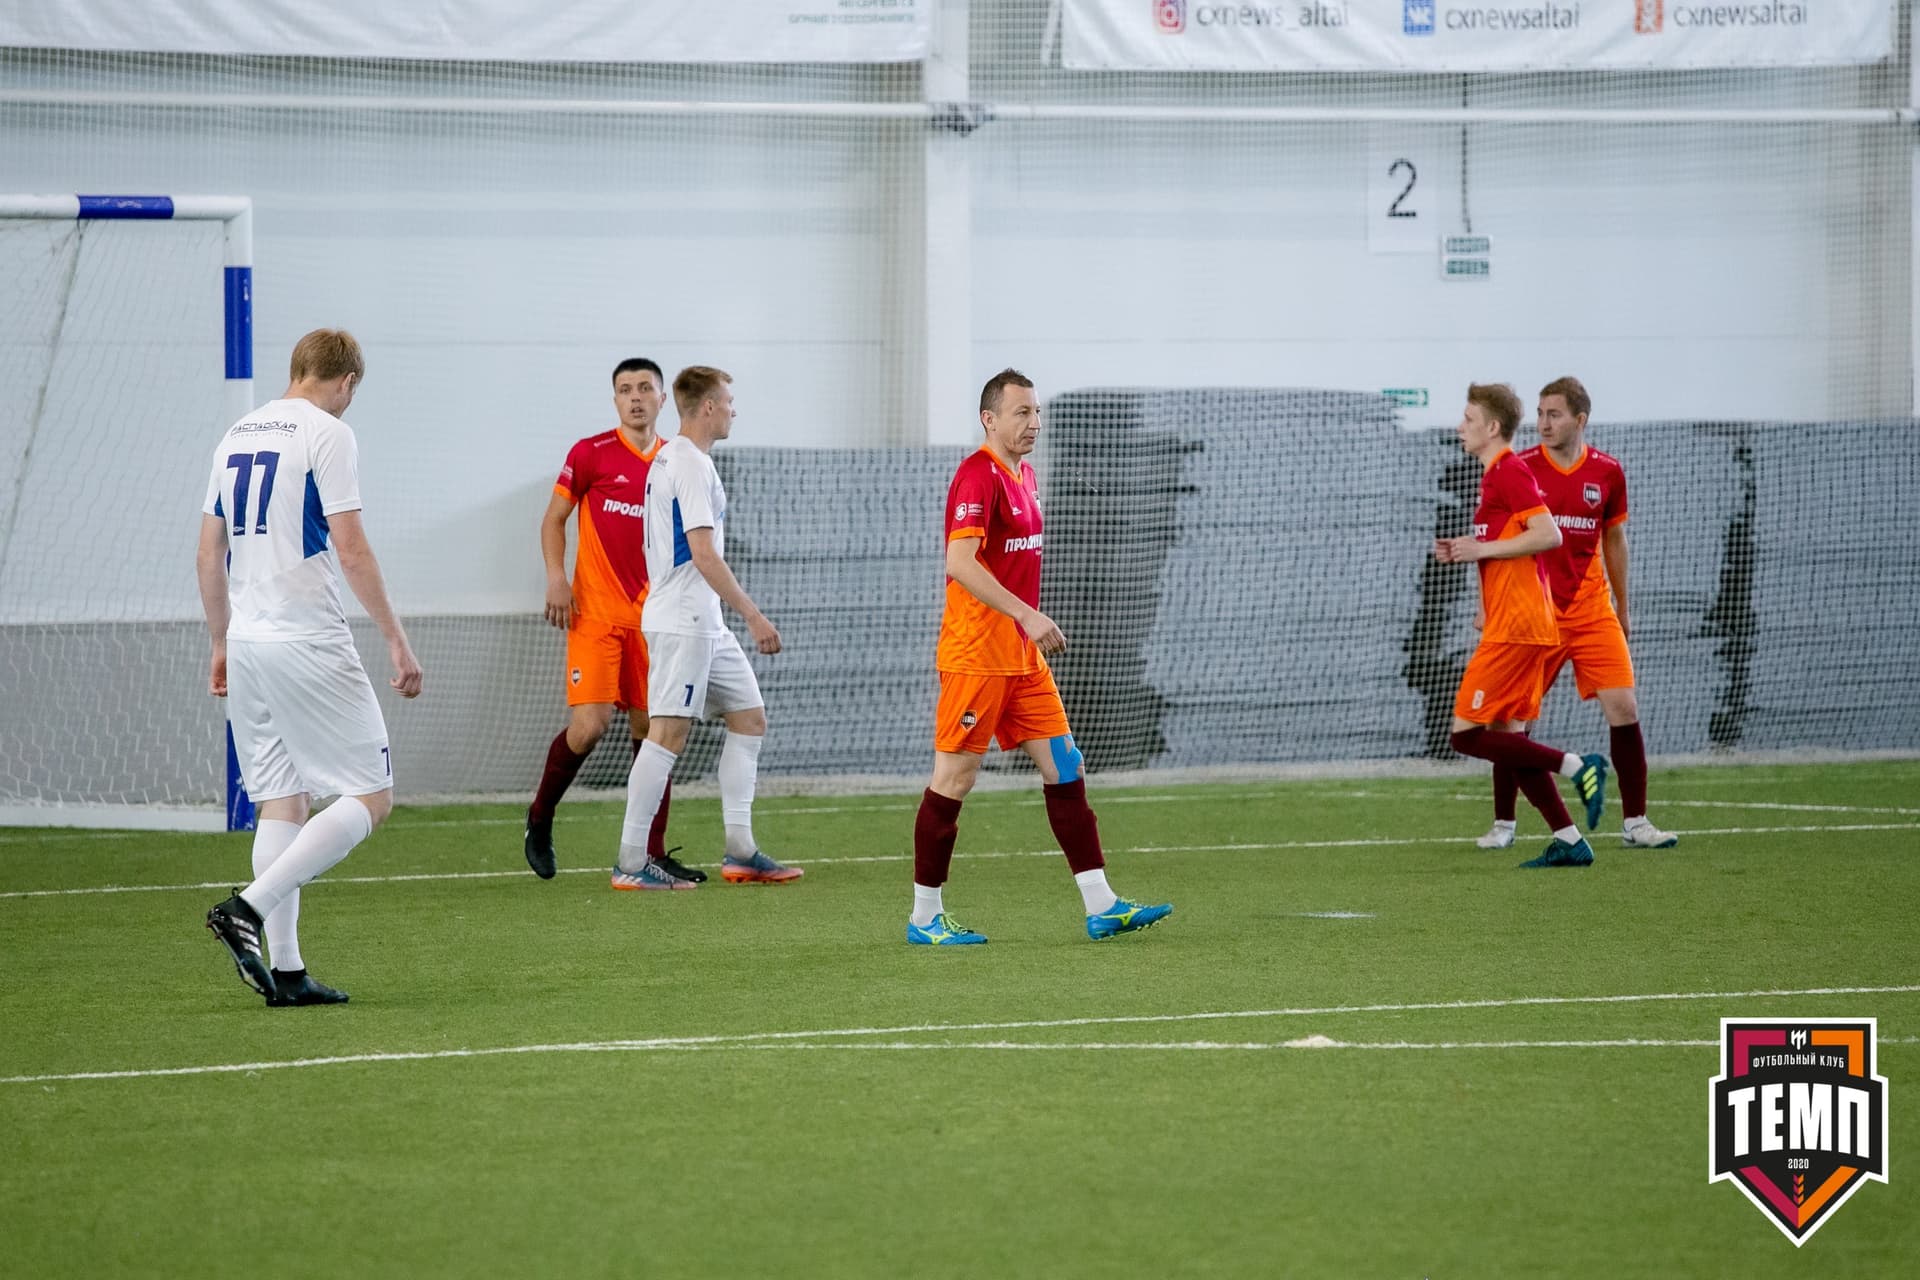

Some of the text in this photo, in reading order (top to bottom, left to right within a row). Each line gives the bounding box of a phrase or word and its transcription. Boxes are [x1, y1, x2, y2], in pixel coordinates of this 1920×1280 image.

[1196, 0, 1349, 31] cxnews_altai
[1445, 0, 1580, 30] cxnewsaltai
[1673, 0, 1807, 27] cxnewsaltai
[1387, 158, 1417, 217] 2
